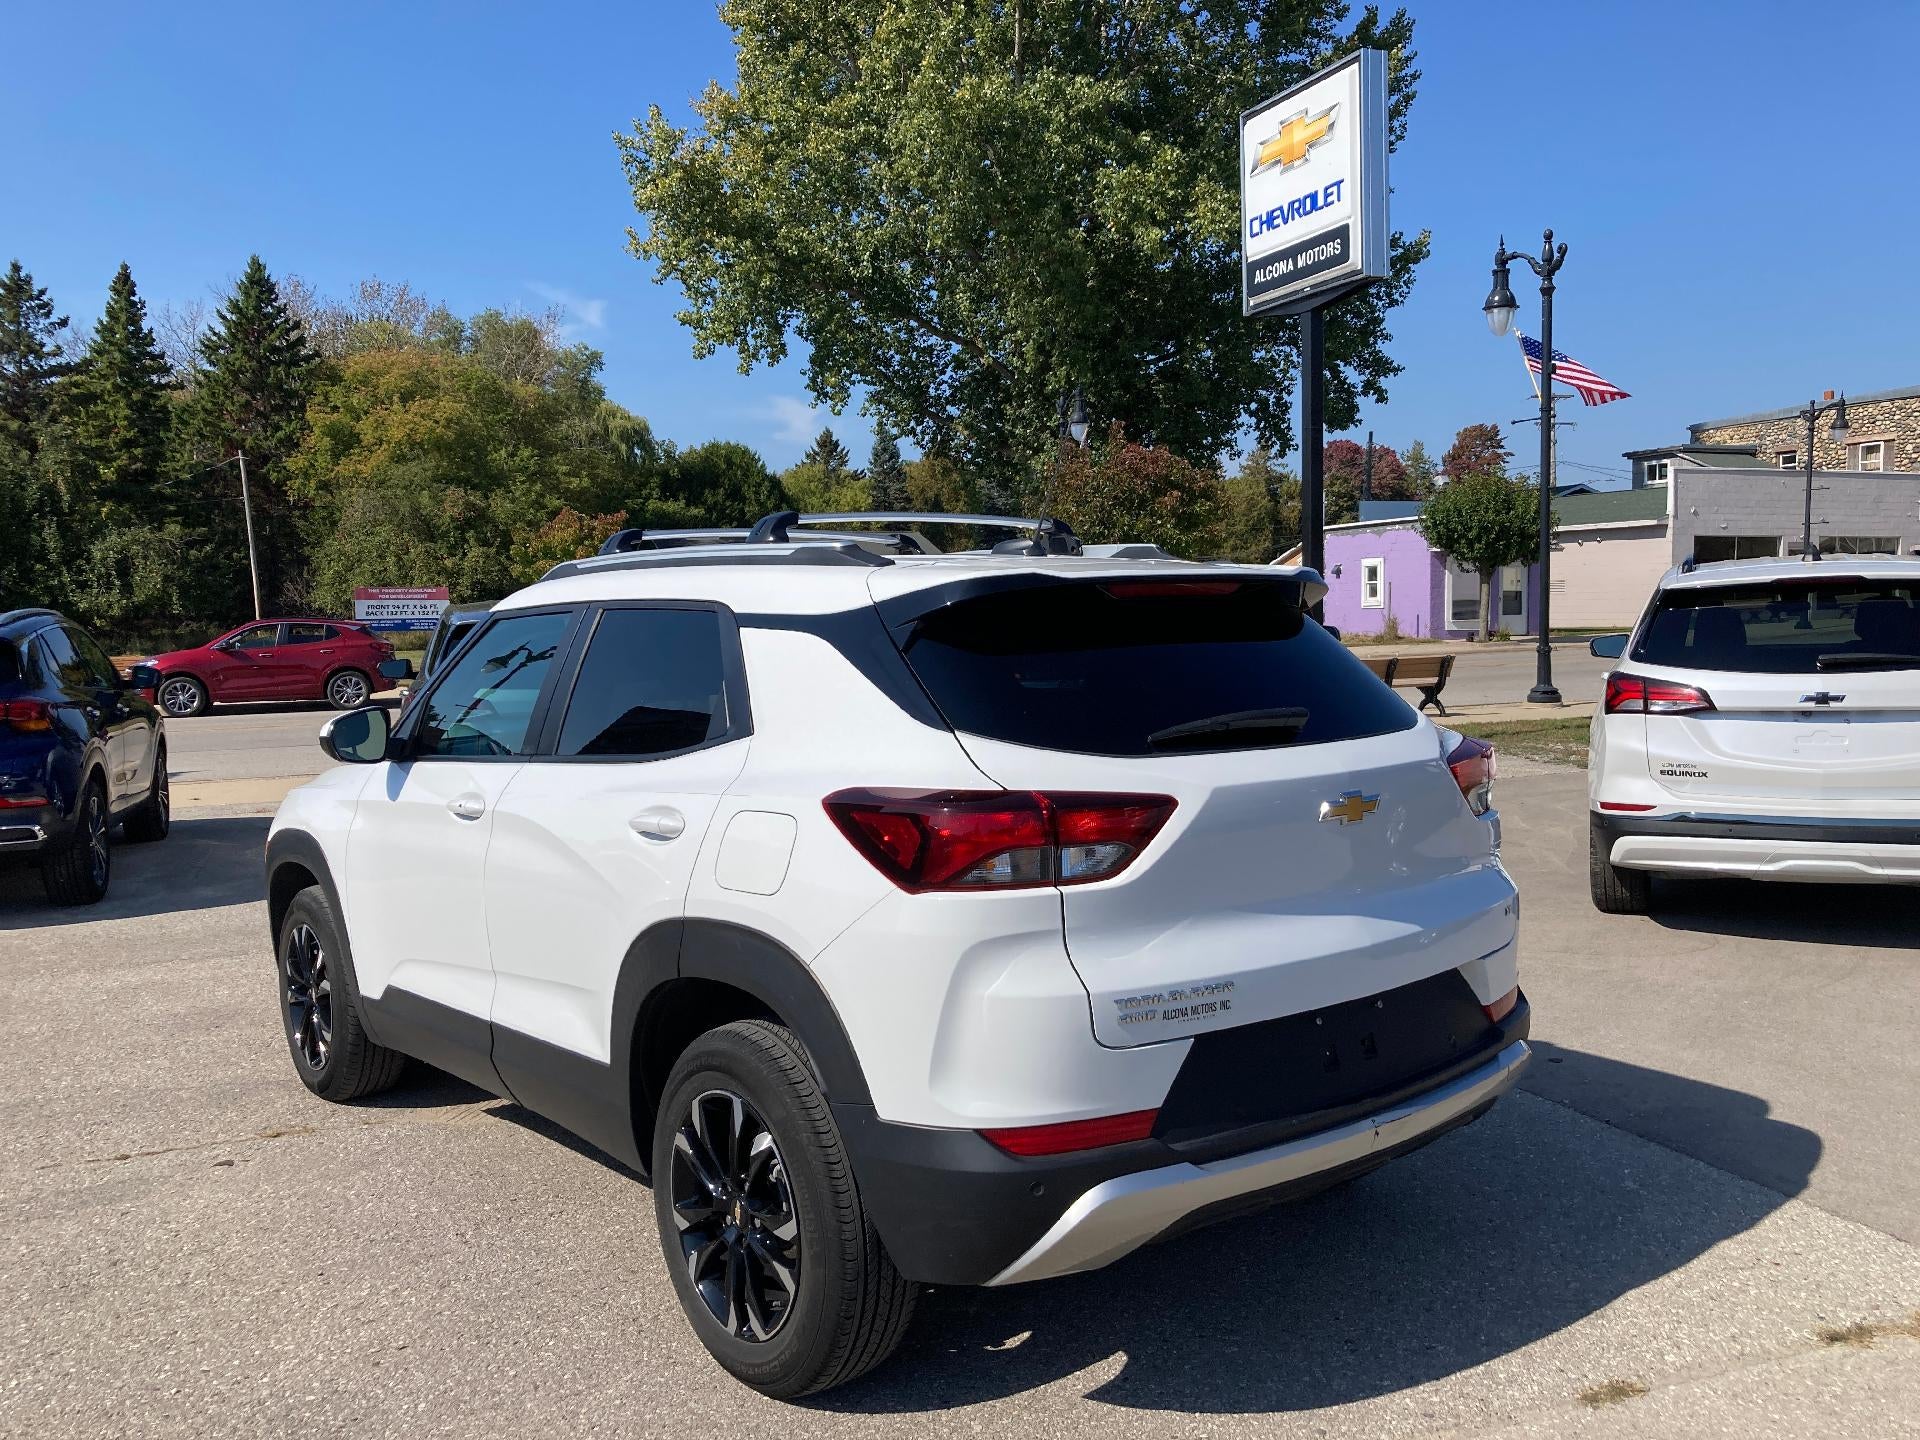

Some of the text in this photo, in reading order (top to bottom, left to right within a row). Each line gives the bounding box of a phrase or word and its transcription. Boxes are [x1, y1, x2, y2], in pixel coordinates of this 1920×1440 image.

[1249, 178, 1345, 239] CHEVROLET
[1254, 238, 1342, 285] ALCONA MOTORS
[1660, 769, 1708, 778] EQUINOX
[1162, 1006, 1189, 1021] ALCONA
[1190, 1002, 1217, 1017] MOTORS
